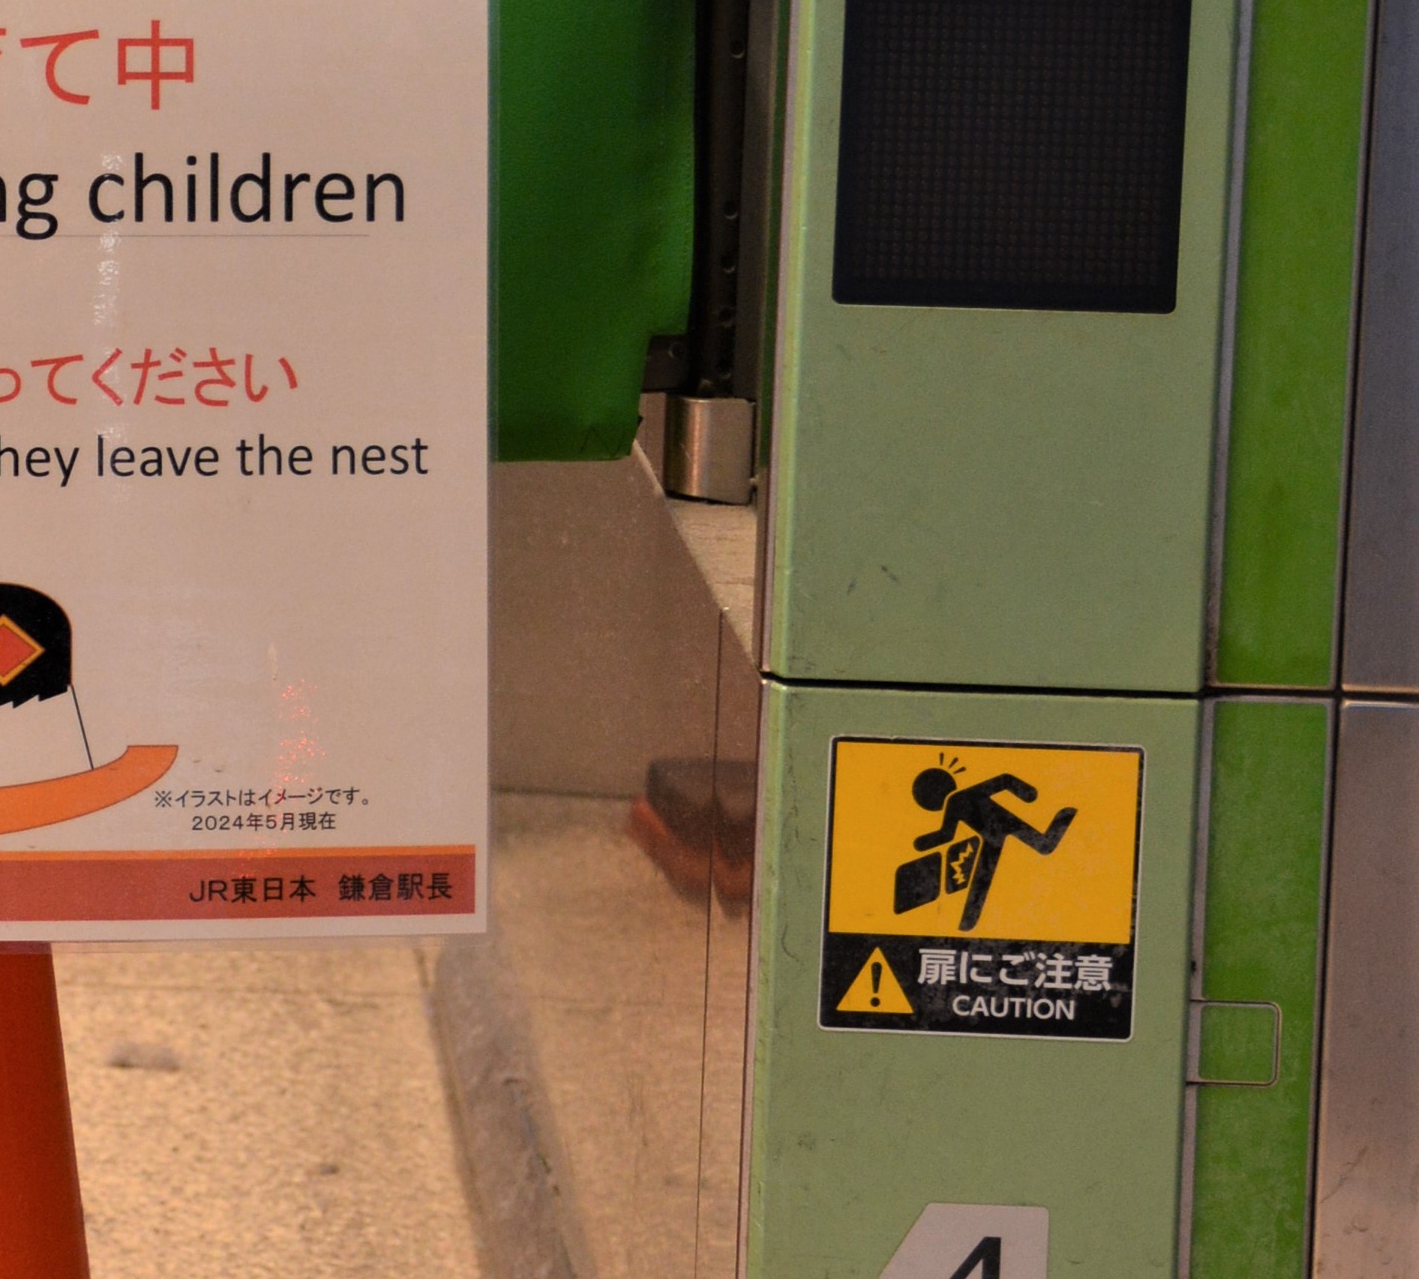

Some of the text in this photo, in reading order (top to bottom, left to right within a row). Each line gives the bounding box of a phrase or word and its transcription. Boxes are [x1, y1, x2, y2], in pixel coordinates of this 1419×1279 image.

[88, 152, 406, 225] children
[97, 435, 220, 478] leave
[236, 434, 314, 478] the
[332, 438, 430, 477] nest
[191, 812, 337, 832] 2024年5月現在
[189, 872, 453, 904] JR東日本 鎌倉駅長
[917, 947, 1115, 992] 扉にご注意
[951, 994, 1077, 1021] CAUTION
